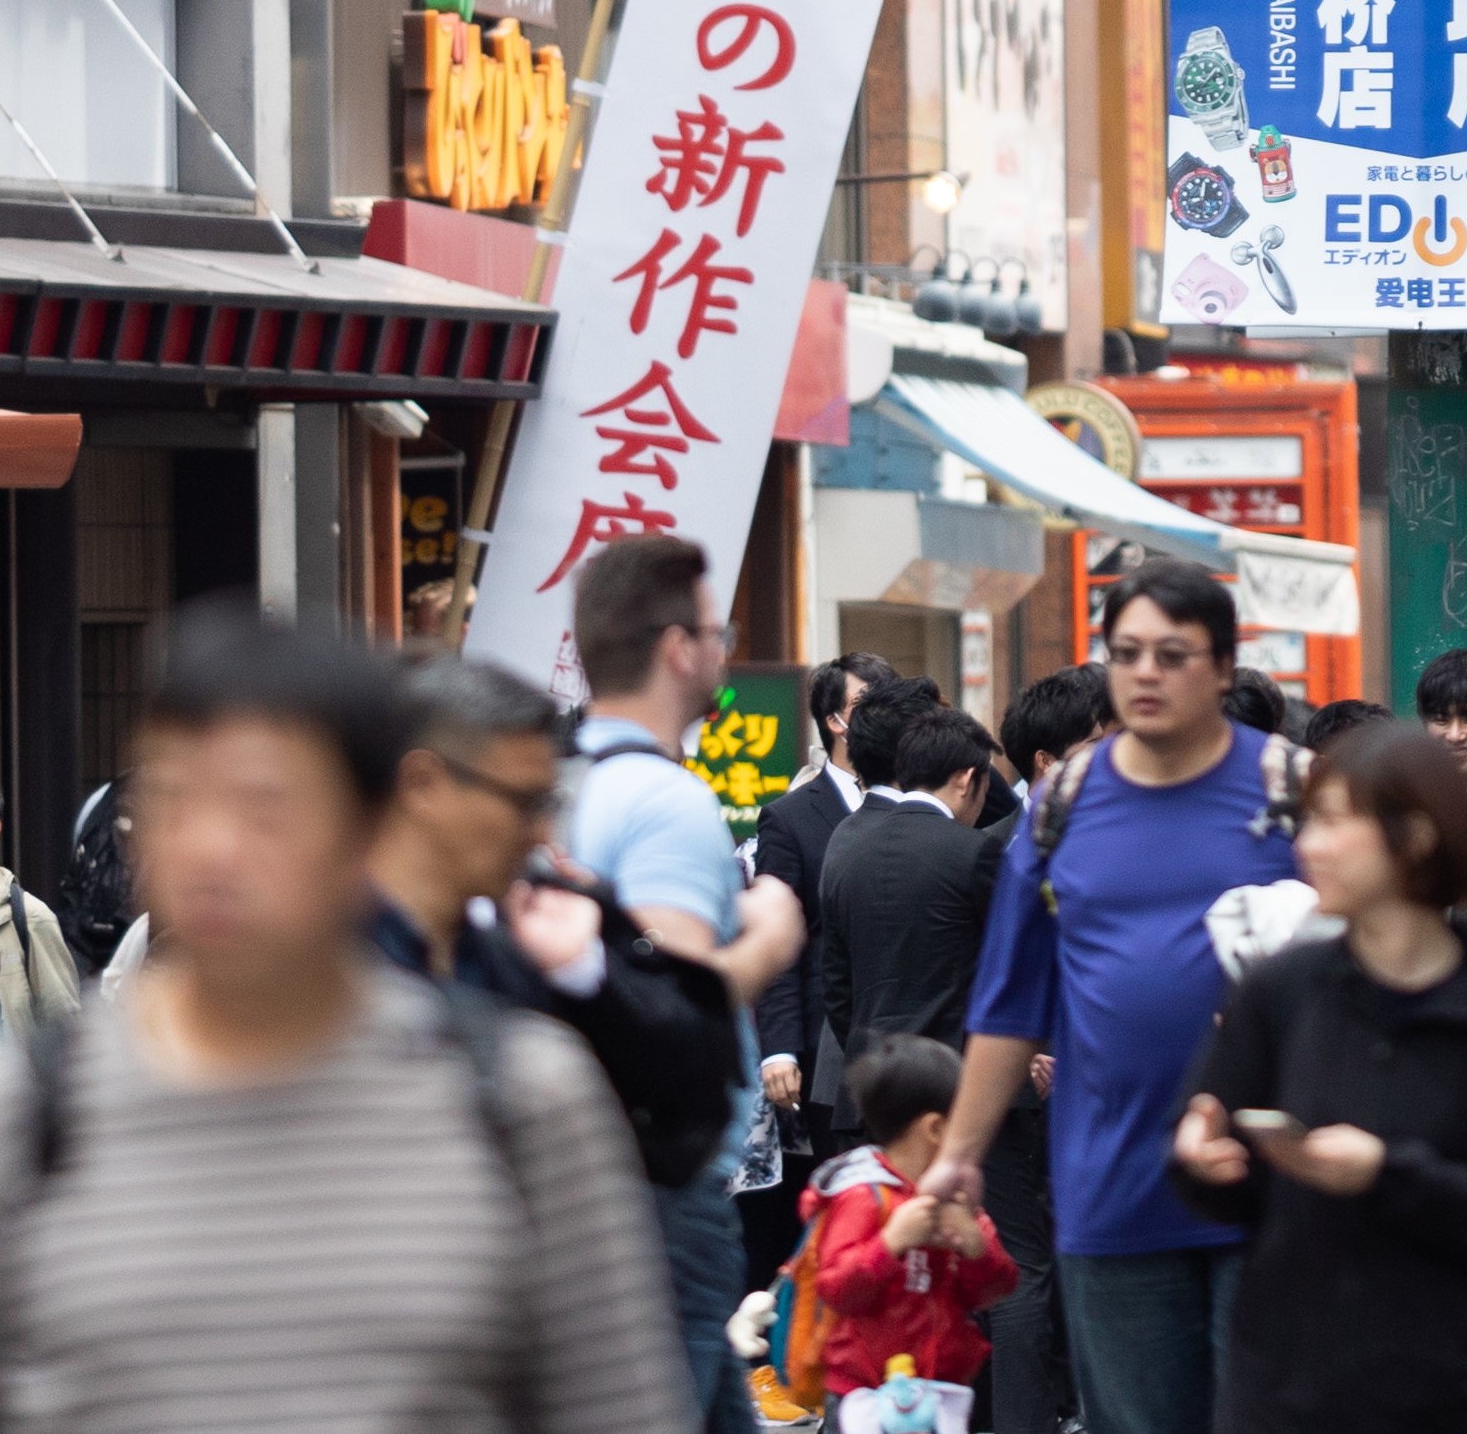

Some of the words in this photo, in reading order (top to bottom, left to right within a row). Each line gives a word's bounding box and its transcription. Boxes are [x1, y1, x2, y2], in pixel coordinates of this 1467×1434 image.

[1323, 248, 1408, 267] エディオン
[1374, 275, 1467, 310] 爱电王
